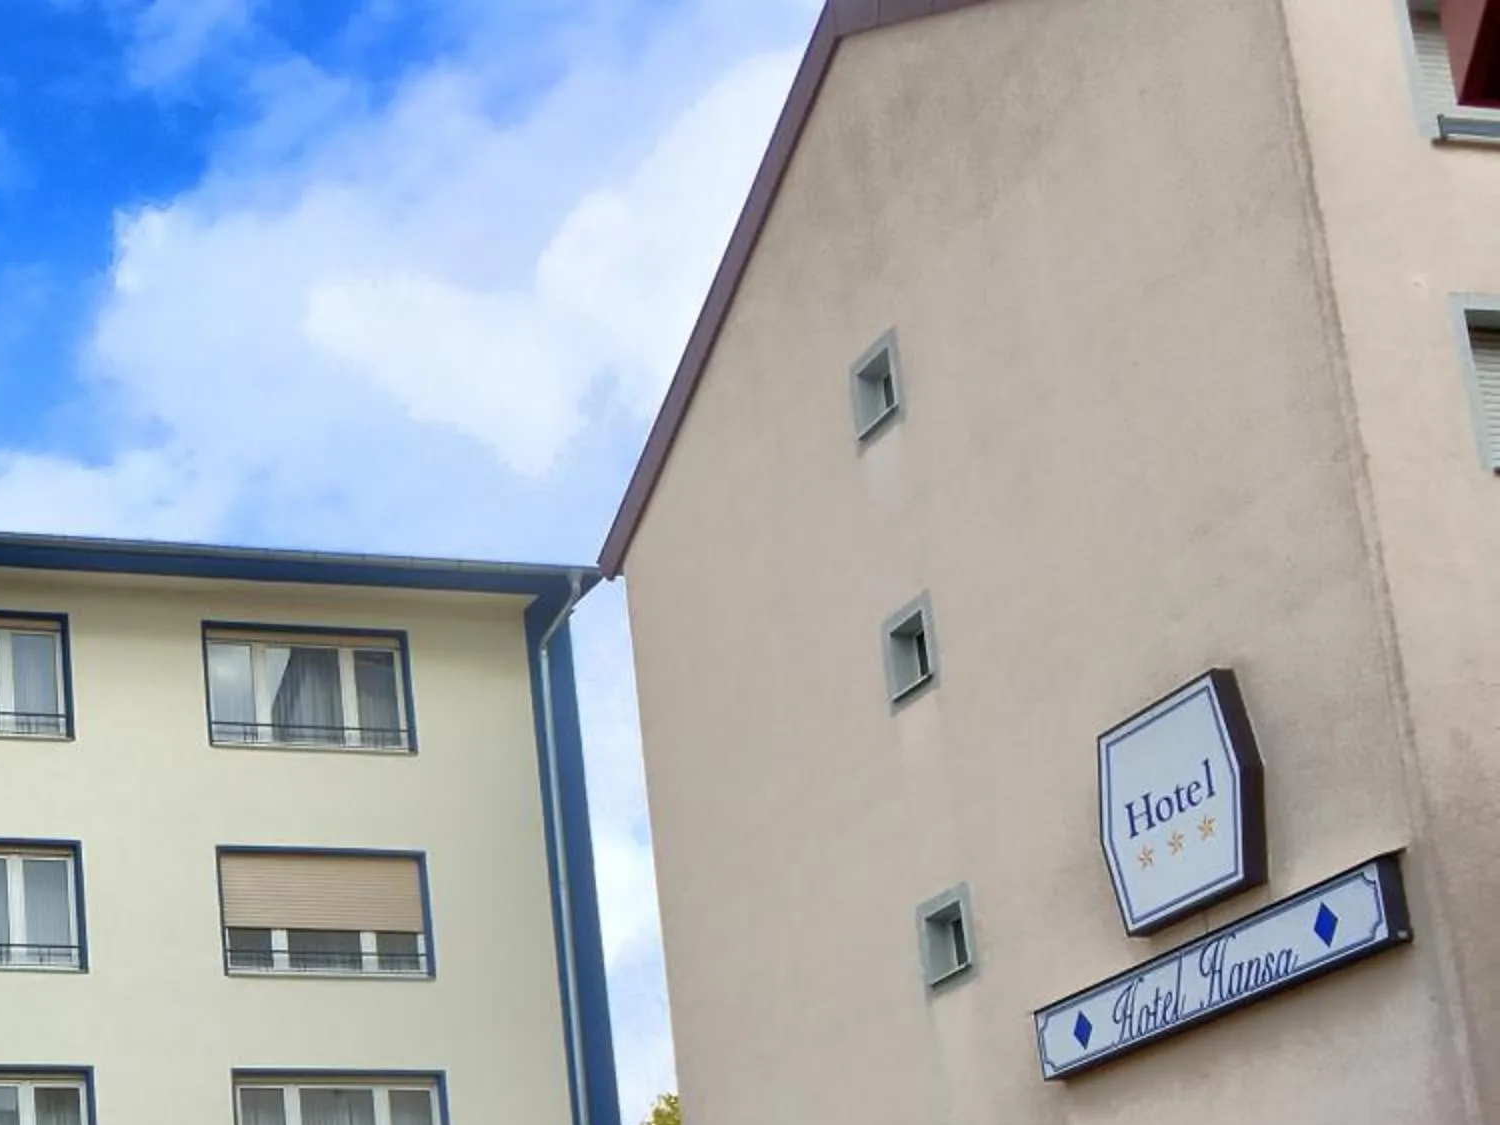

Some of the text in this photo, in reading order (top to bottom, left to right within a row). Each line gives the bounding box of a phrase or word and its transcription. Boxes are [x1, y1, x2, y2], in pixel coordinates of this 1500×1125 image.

[1125, 758, 1217, 839] Hotel
[1111, 931, 1300, 1045] Hotel Hansa
